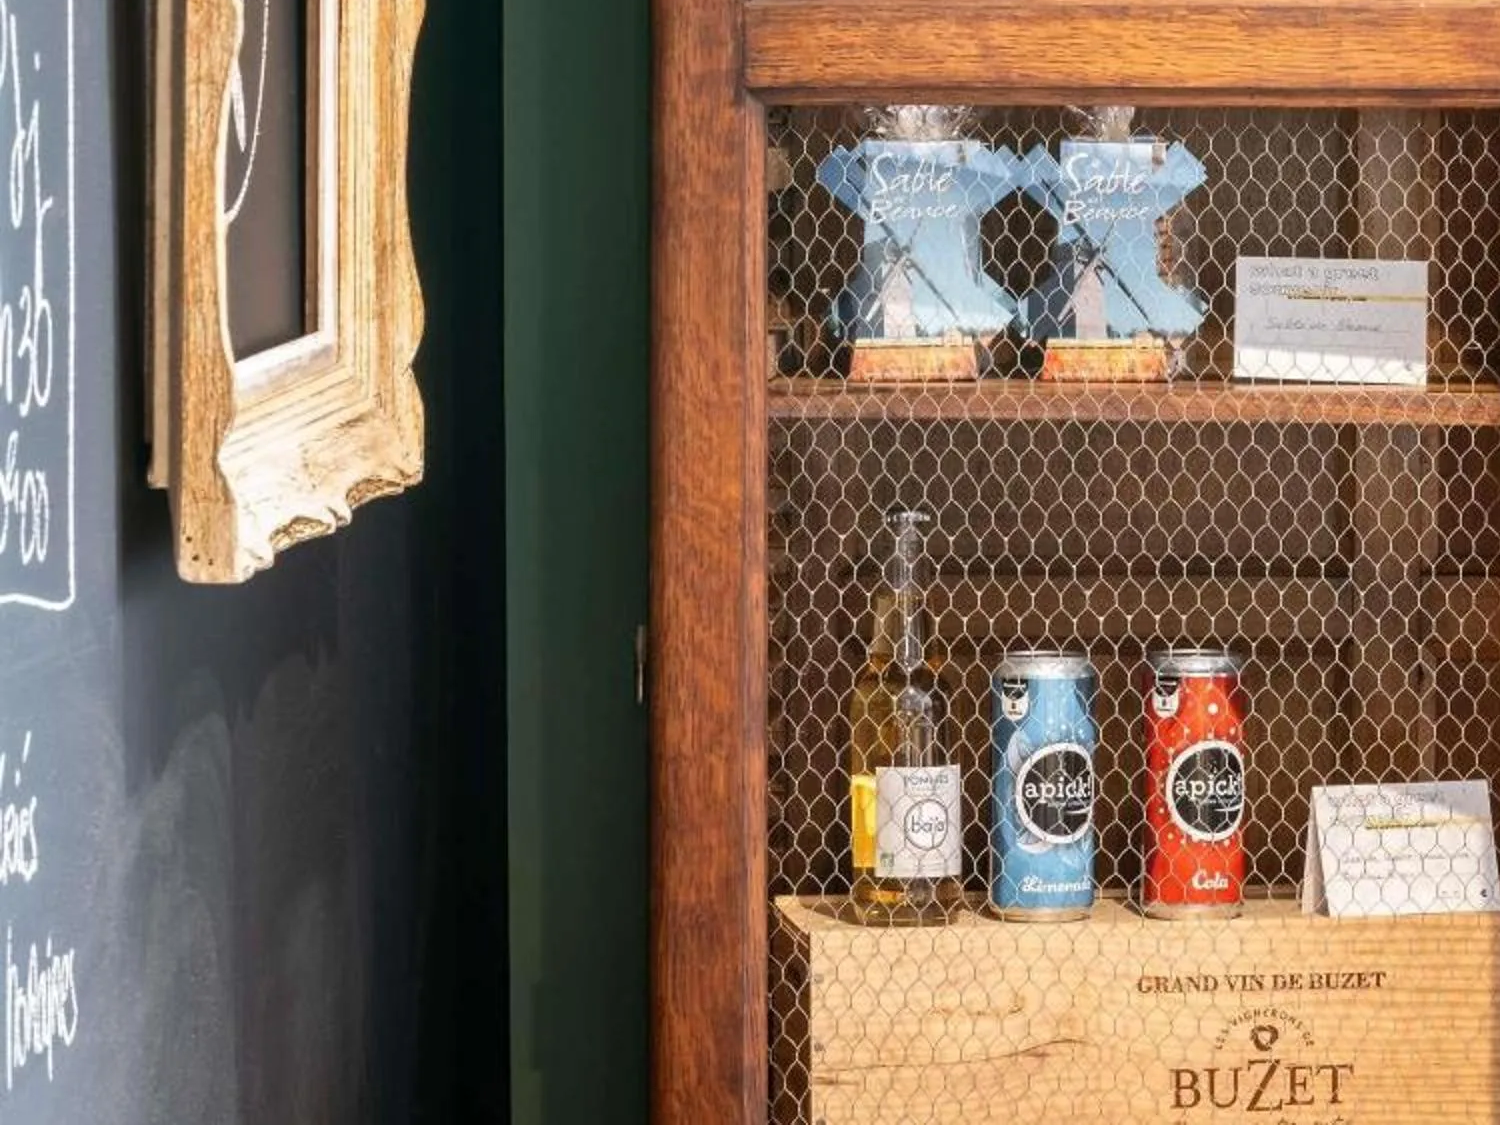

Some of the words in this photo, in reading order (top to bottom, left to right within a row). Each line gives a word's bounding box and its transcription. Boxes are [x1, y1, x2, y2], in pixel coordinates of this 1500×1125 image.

[1192, 869, 1229, 891] Cola
[1136, 974, 1219, 994] GRAND
[1226, 974, 1265, 992] VIN
[1271, 973, 1303, 991] DE
[1309, 971, 1387, 989] BUZET
[1169, 1059, 1355, 1112] BUZET
